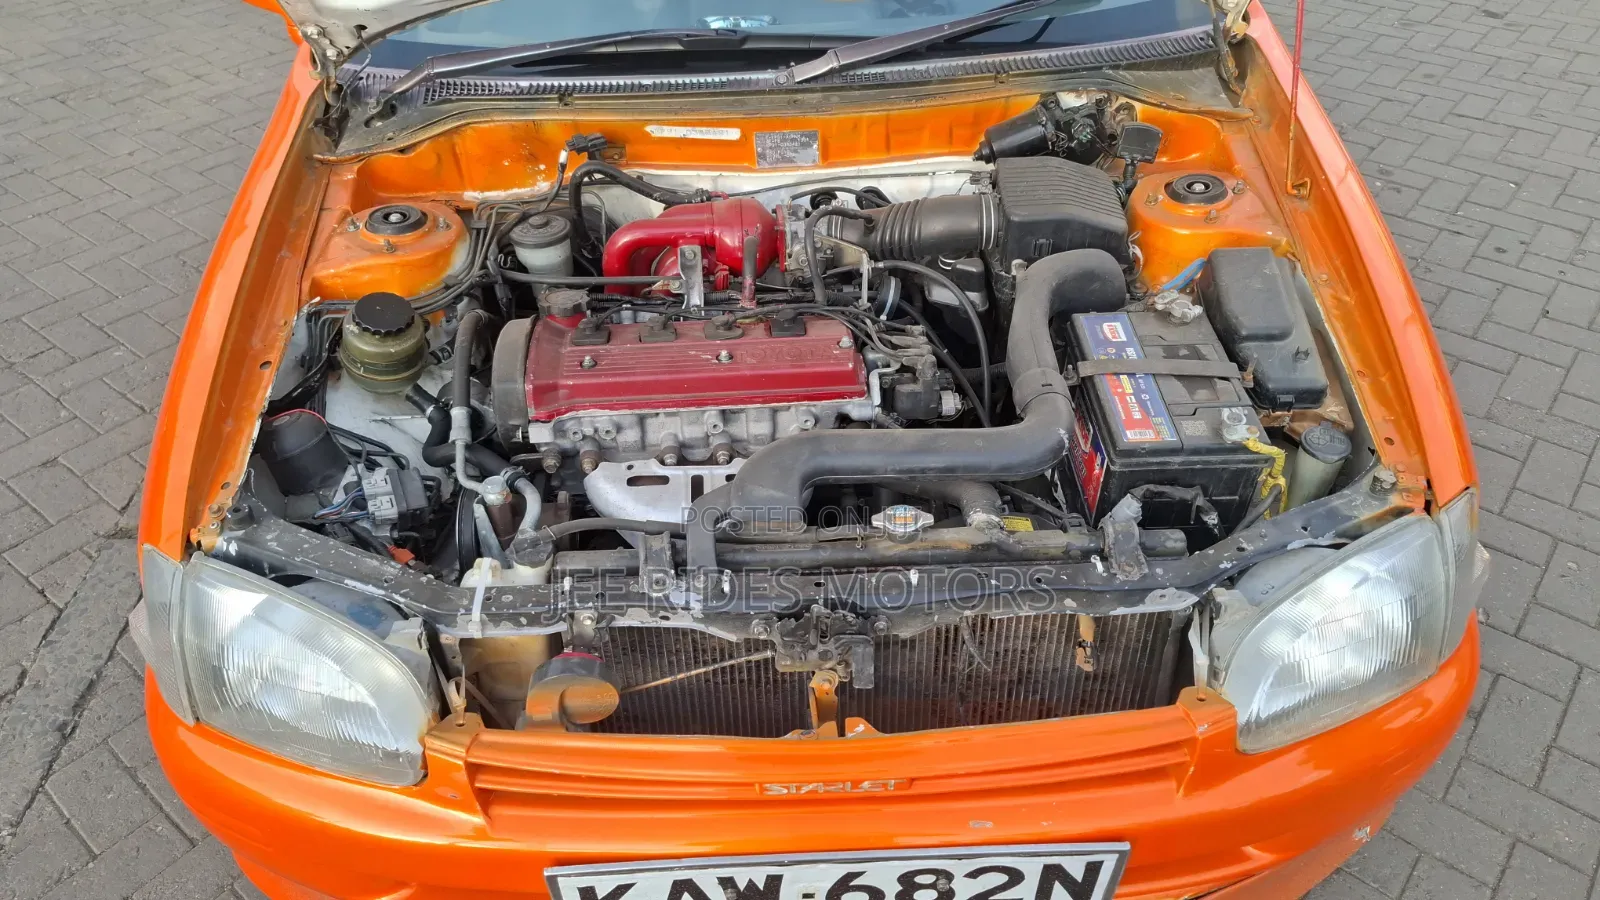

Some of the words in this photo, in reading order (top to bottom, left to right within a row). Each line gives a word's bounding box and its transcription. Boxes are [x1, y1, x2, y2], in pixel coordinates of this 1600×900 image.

[736, 345, 839, 363] TOYOTA
[762, 778, 908, 796] STARLET
[824, 860, 1105, 900] 682N
